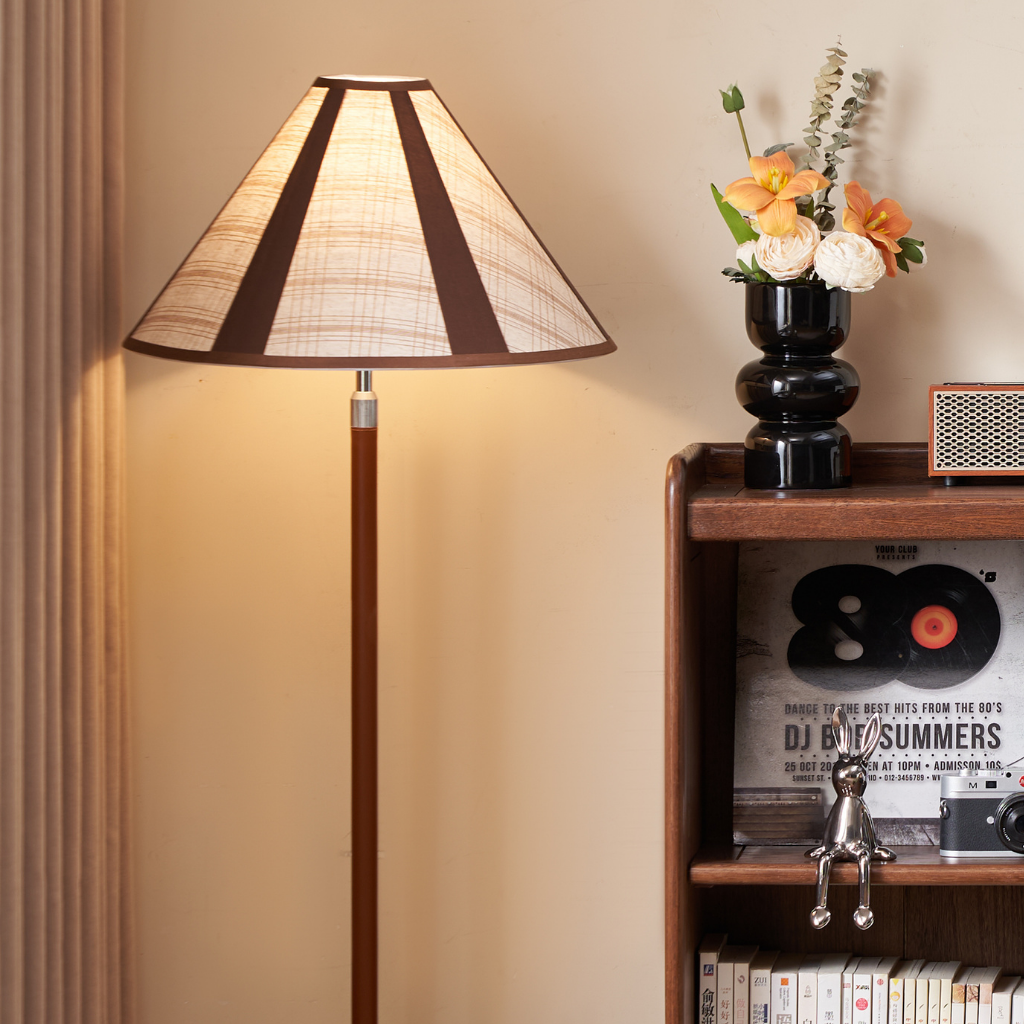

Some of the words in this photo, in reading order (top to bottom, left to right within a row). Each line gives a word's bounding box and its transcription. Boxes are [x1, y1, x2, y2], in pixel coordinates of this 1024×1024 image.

[875, 545, 895, 554] YOUR
[898, 545, 918, 554] CLUB
[785, 703, 819, 715] DANCE
[823, 703, 836, 715] TO
[842, 703, 860, 715] THE
[864, 703, 890, 714] BEST
[894, 702, 918, 714] HITS
[922, 702, 950, 714] FROM
[955, 702, 974, 713] THE
[978, 702, 1002, 713] 80'S
[784, 723, 810, 751] DJ
[880, 723, 1001, 750] SUMMERS
[784, 761, 796, 772] 25
[800, 761, 816, 772] OCT
[882, 761, 893, 771] AT
[898, 760, 921, 771] 10PM
[792, 774, 815, 782] SUNSET
